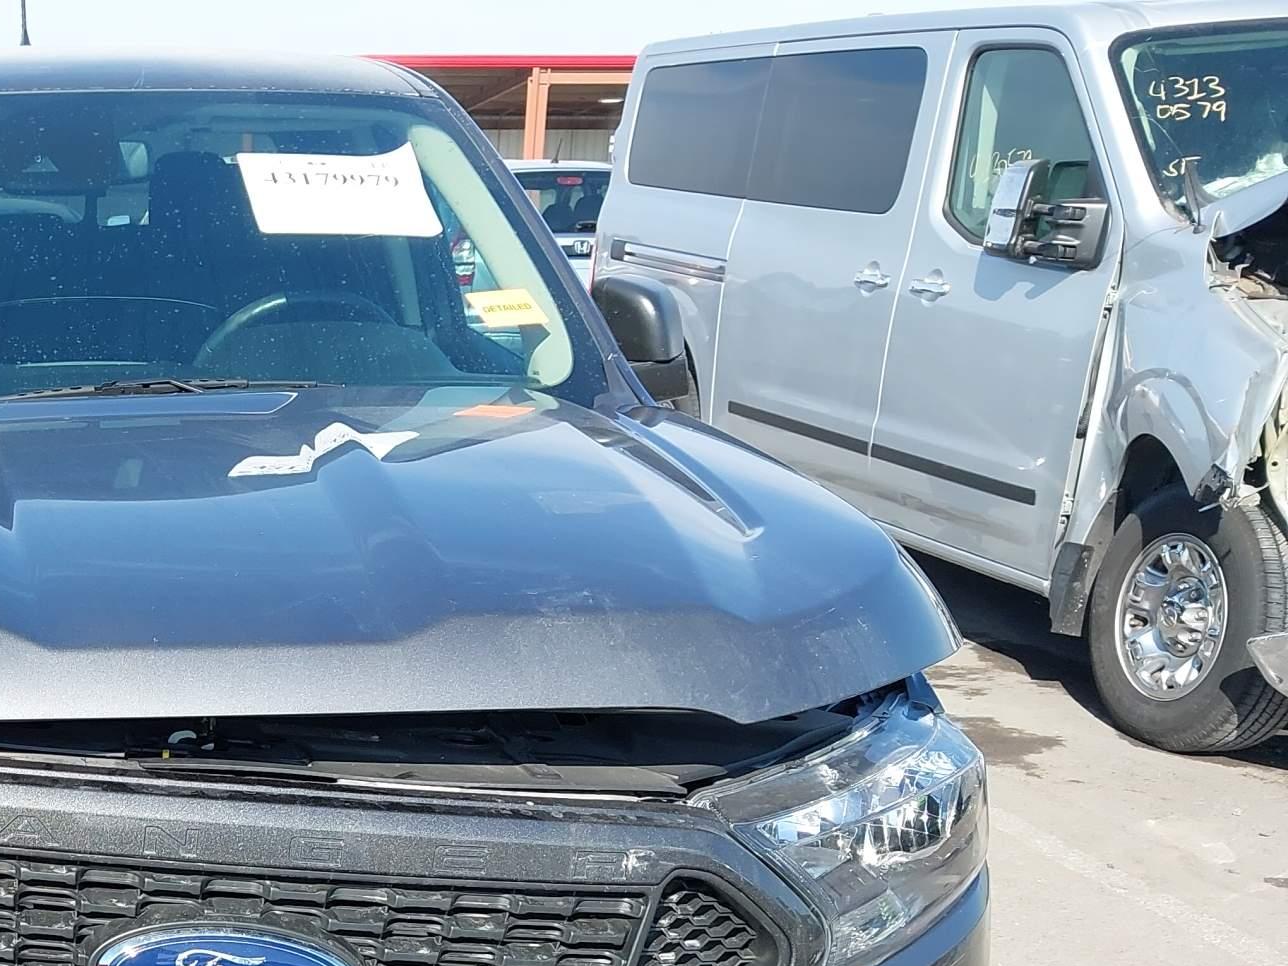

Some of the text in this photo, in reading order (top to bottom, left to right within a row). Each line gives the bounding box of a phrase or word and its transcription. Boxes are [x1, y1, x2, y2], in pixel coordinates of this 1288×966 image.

[1149, 76, 1225, 100] 4313
[1157, 101, 1226, 122] 0579
[482, 302, 532, 313] DETAILED
